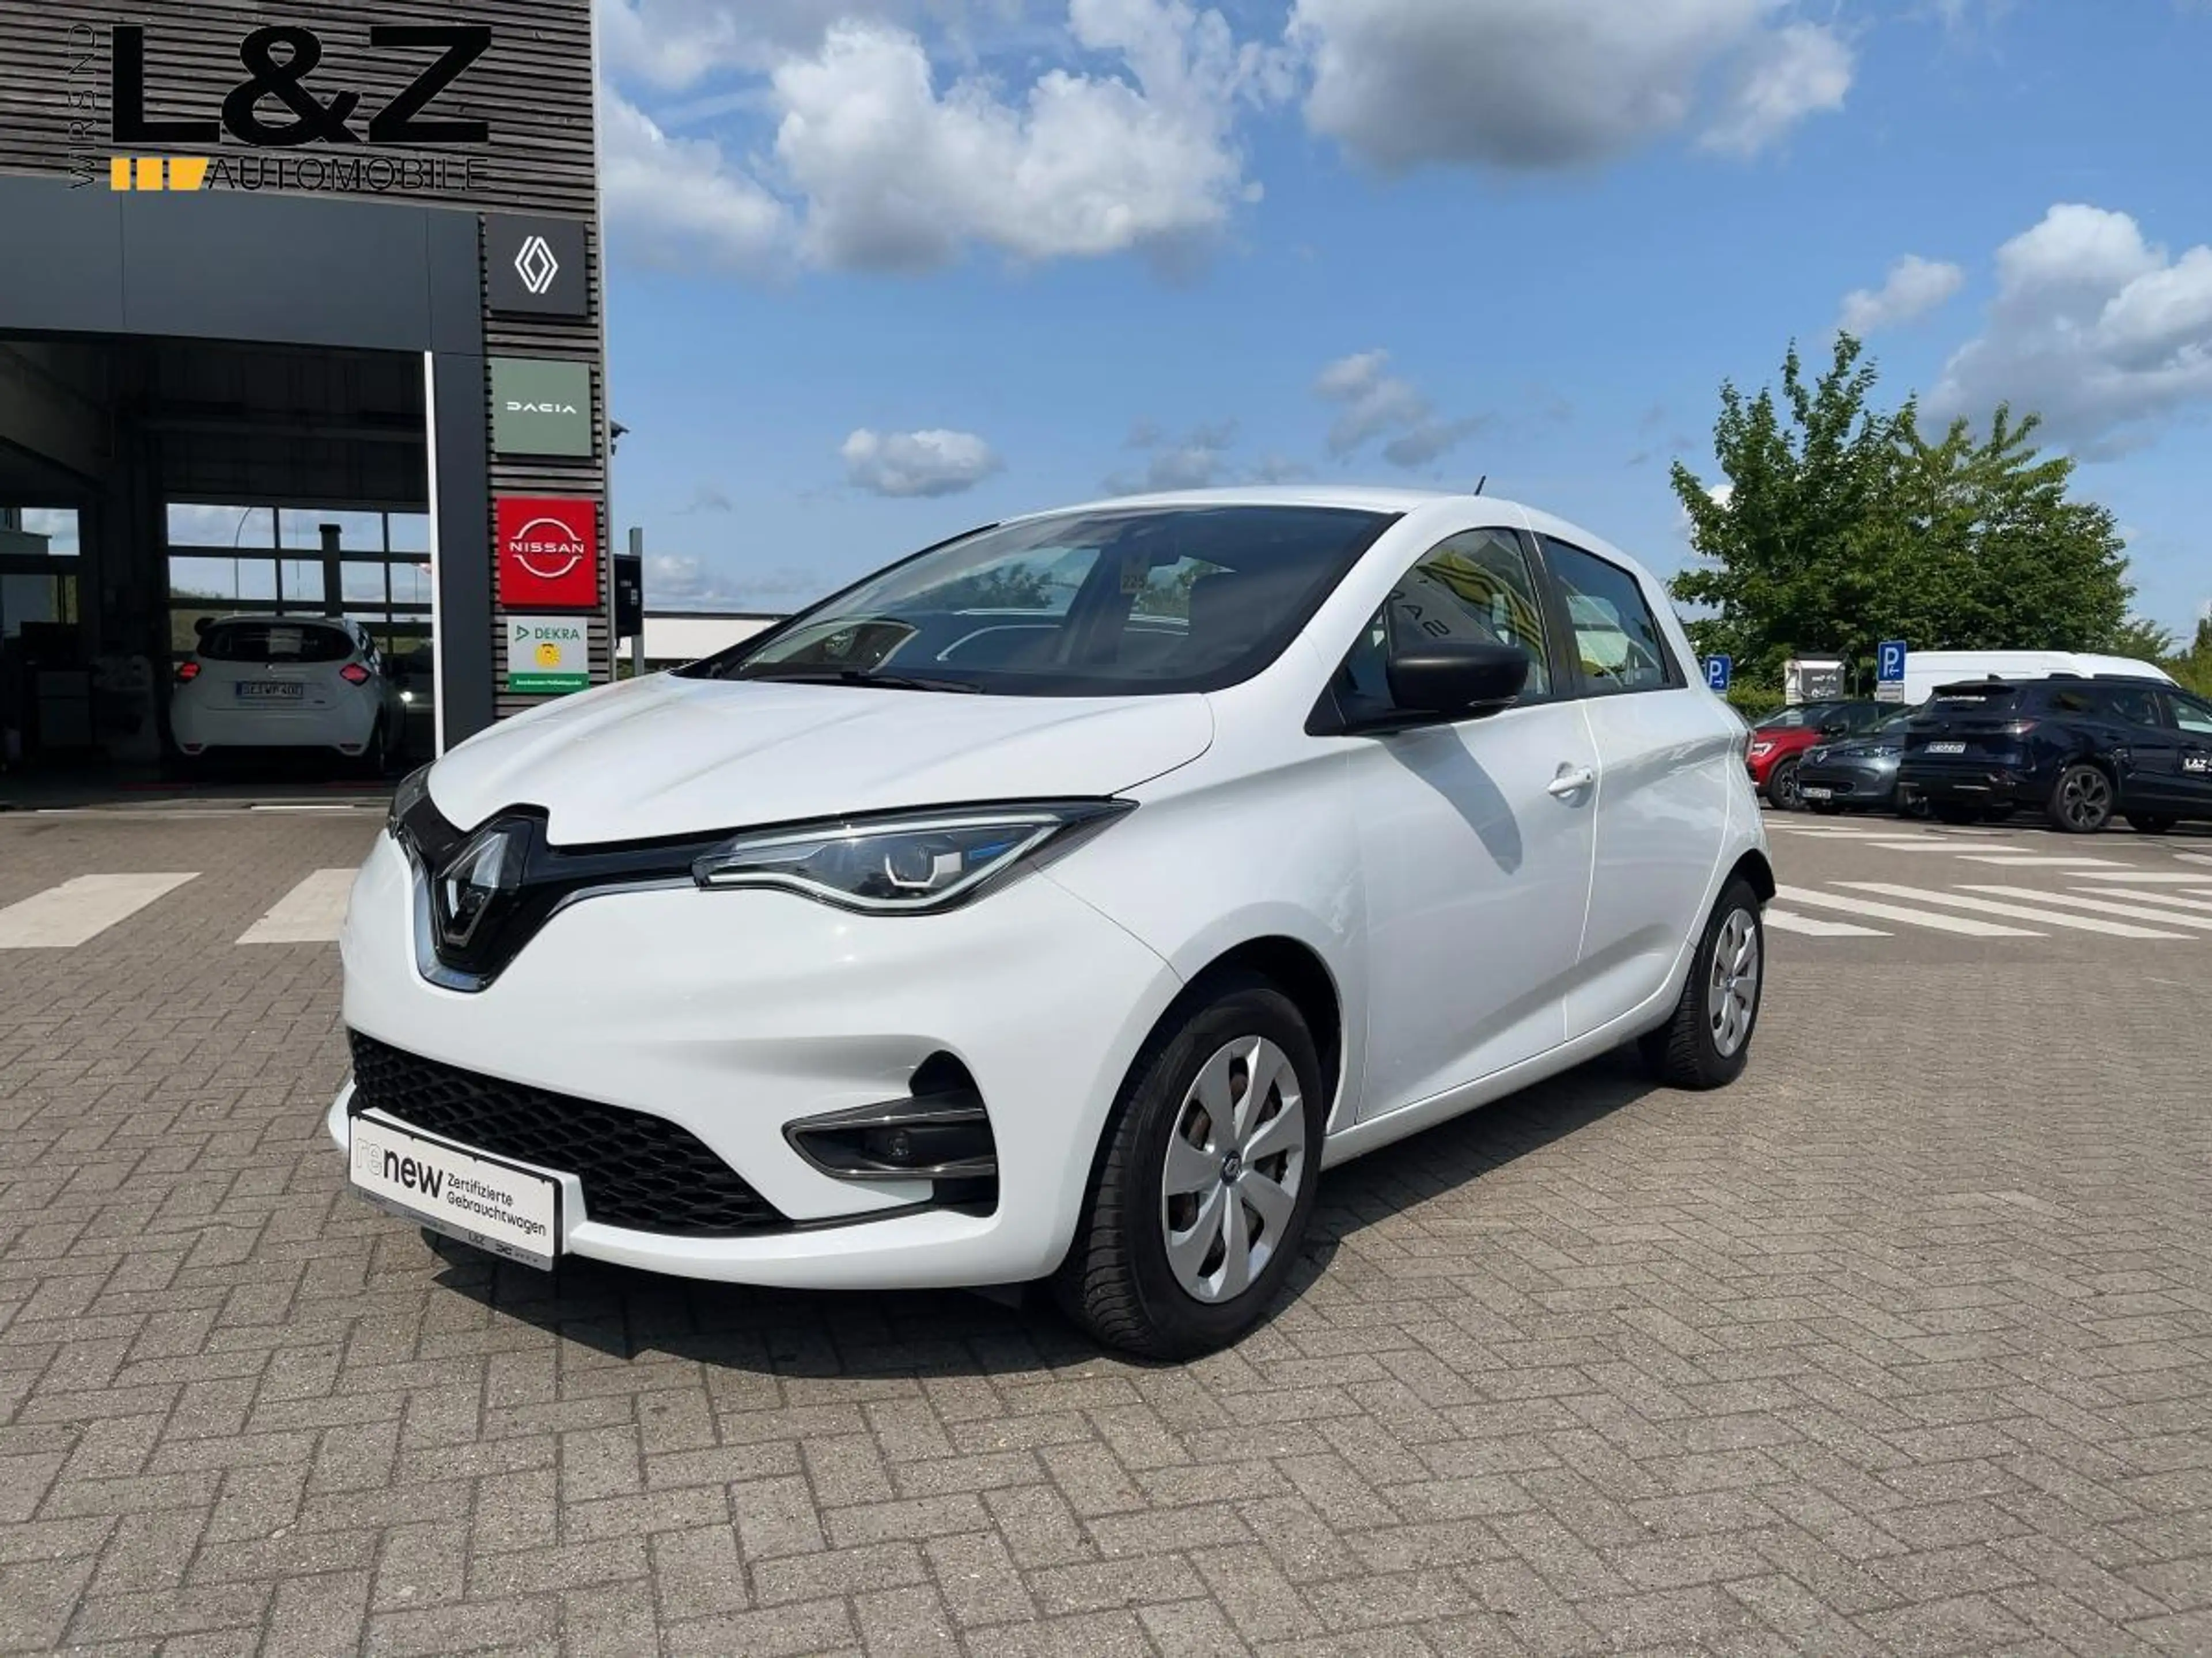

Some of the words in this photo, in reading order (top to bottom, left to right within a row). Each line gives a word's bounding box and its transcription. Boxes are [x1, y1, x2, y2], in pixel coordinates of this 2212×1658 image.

[507, 401, 577, 414] DACIA
[509, 541, 584, 553] NISSAN
[535, 627, 581, 641] DEKRA
[1709, 660, 1724, 686] P
[1883, 647, 1899, 677] P
[448, 1173, 514, 1207] Zertifizierte
[446, 1190, 547, 1236] Gebrauchtwagen
